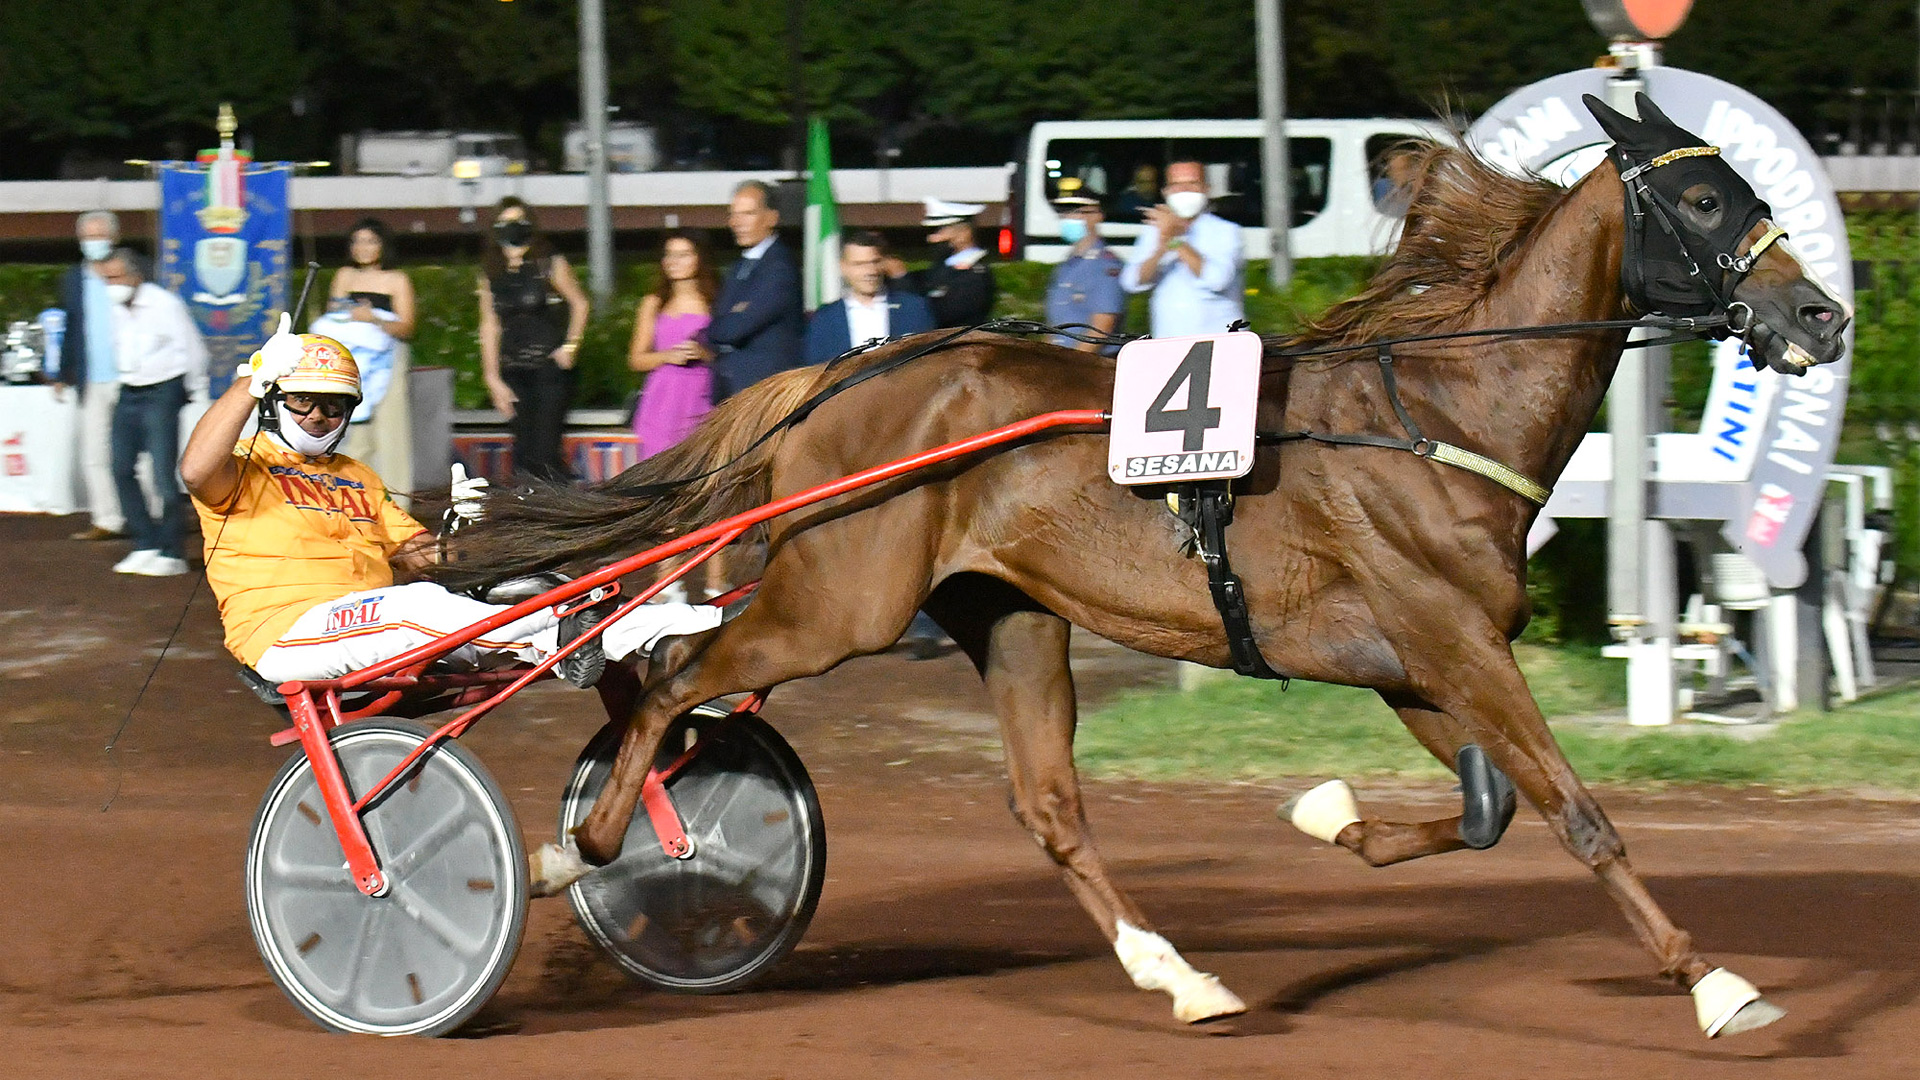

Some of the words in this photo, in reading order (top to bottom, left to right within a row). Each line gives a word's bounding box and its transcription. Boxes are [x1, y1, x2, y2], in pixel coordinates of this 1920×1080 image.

[1145, 340, 1221, 452] 4
[1767, 366, 1835, 475] SNAI
[1126, 451, 1237, 477] SESANA
